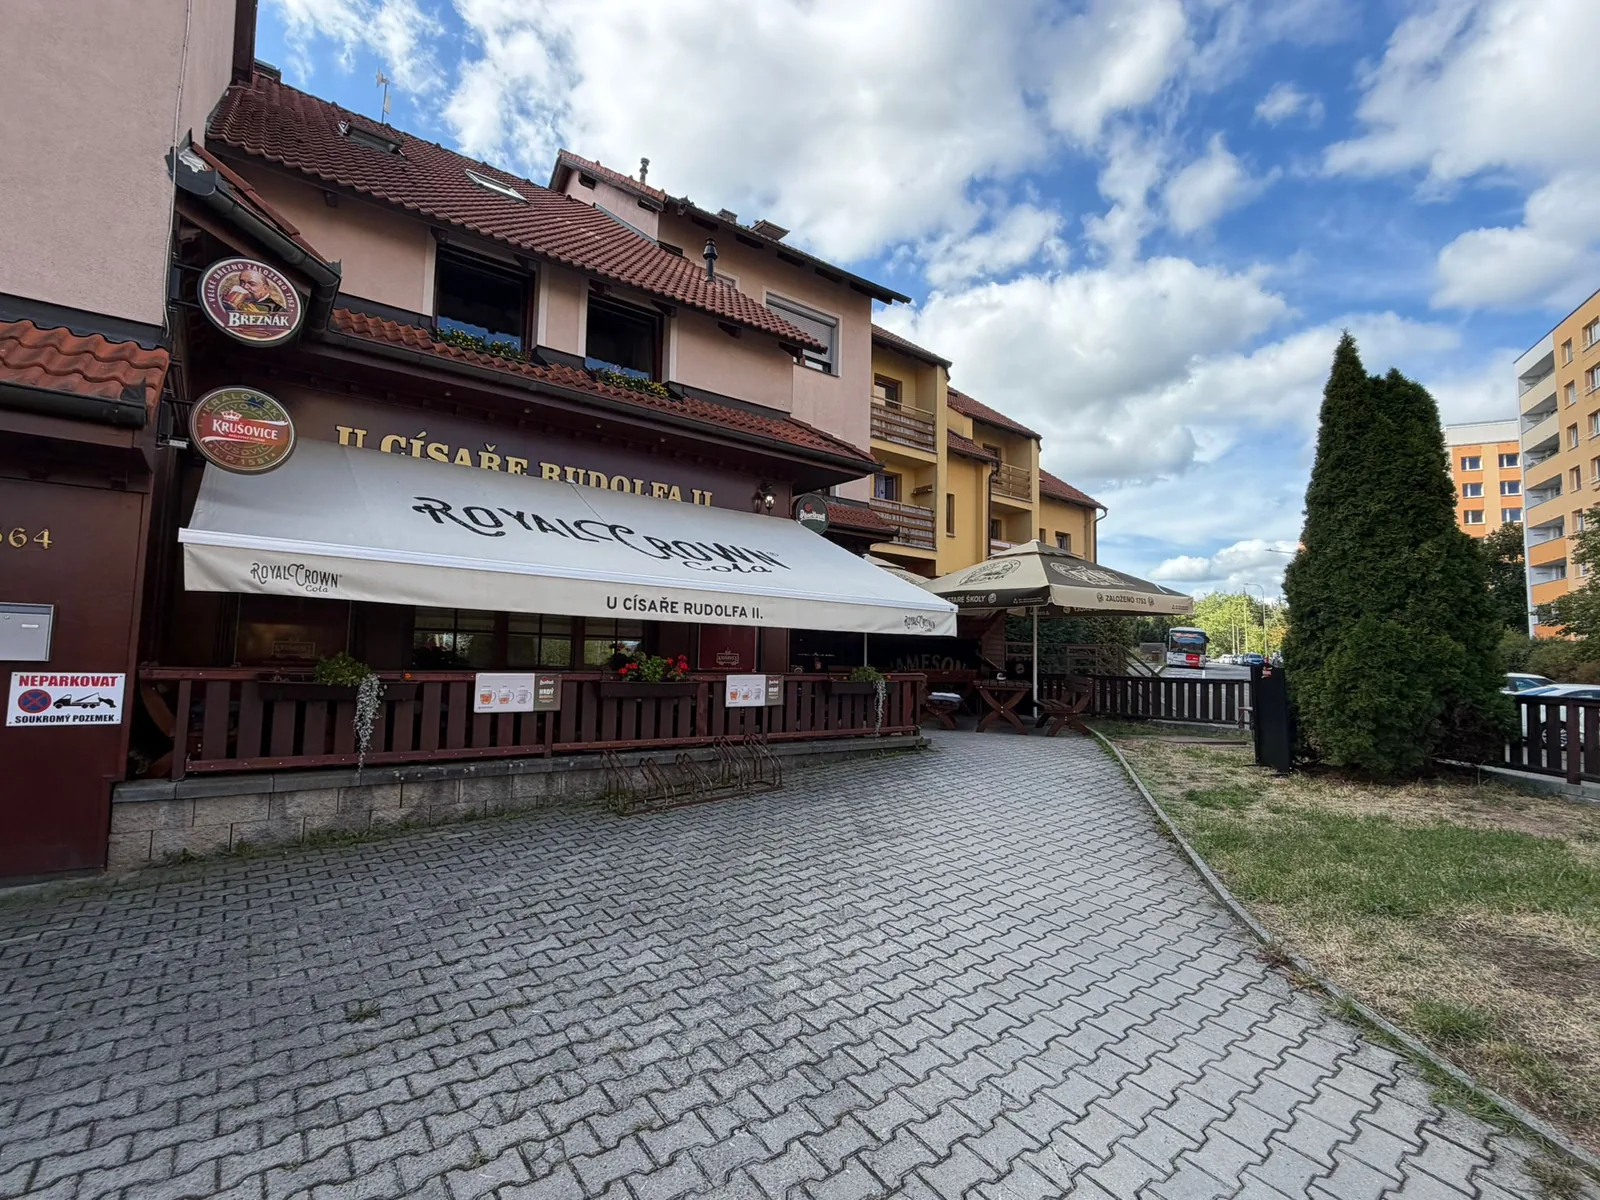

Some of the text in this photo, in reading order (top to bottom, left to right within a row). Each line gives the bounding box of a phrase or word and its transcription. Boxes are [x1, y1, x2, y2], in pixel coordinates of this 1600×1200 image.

[212, 418, 279, 440] KRUŠOVICE
[0, 527, 52, 549] 64
[412, 496, 791, 570] ROYAL CROWN
[250, 562, 338, 588] ROYAL CROWN
[682, 561, 772, 573] Cola
[305, 585, 328, 593] Cola
[606, 594, 763, 619] U CÍSAŘE RUDOLFA II.
[18, 675, 119, 687] NEPARKOVAT
[15, 713, 115, 724] SOUKROMÝ POZEMEK
